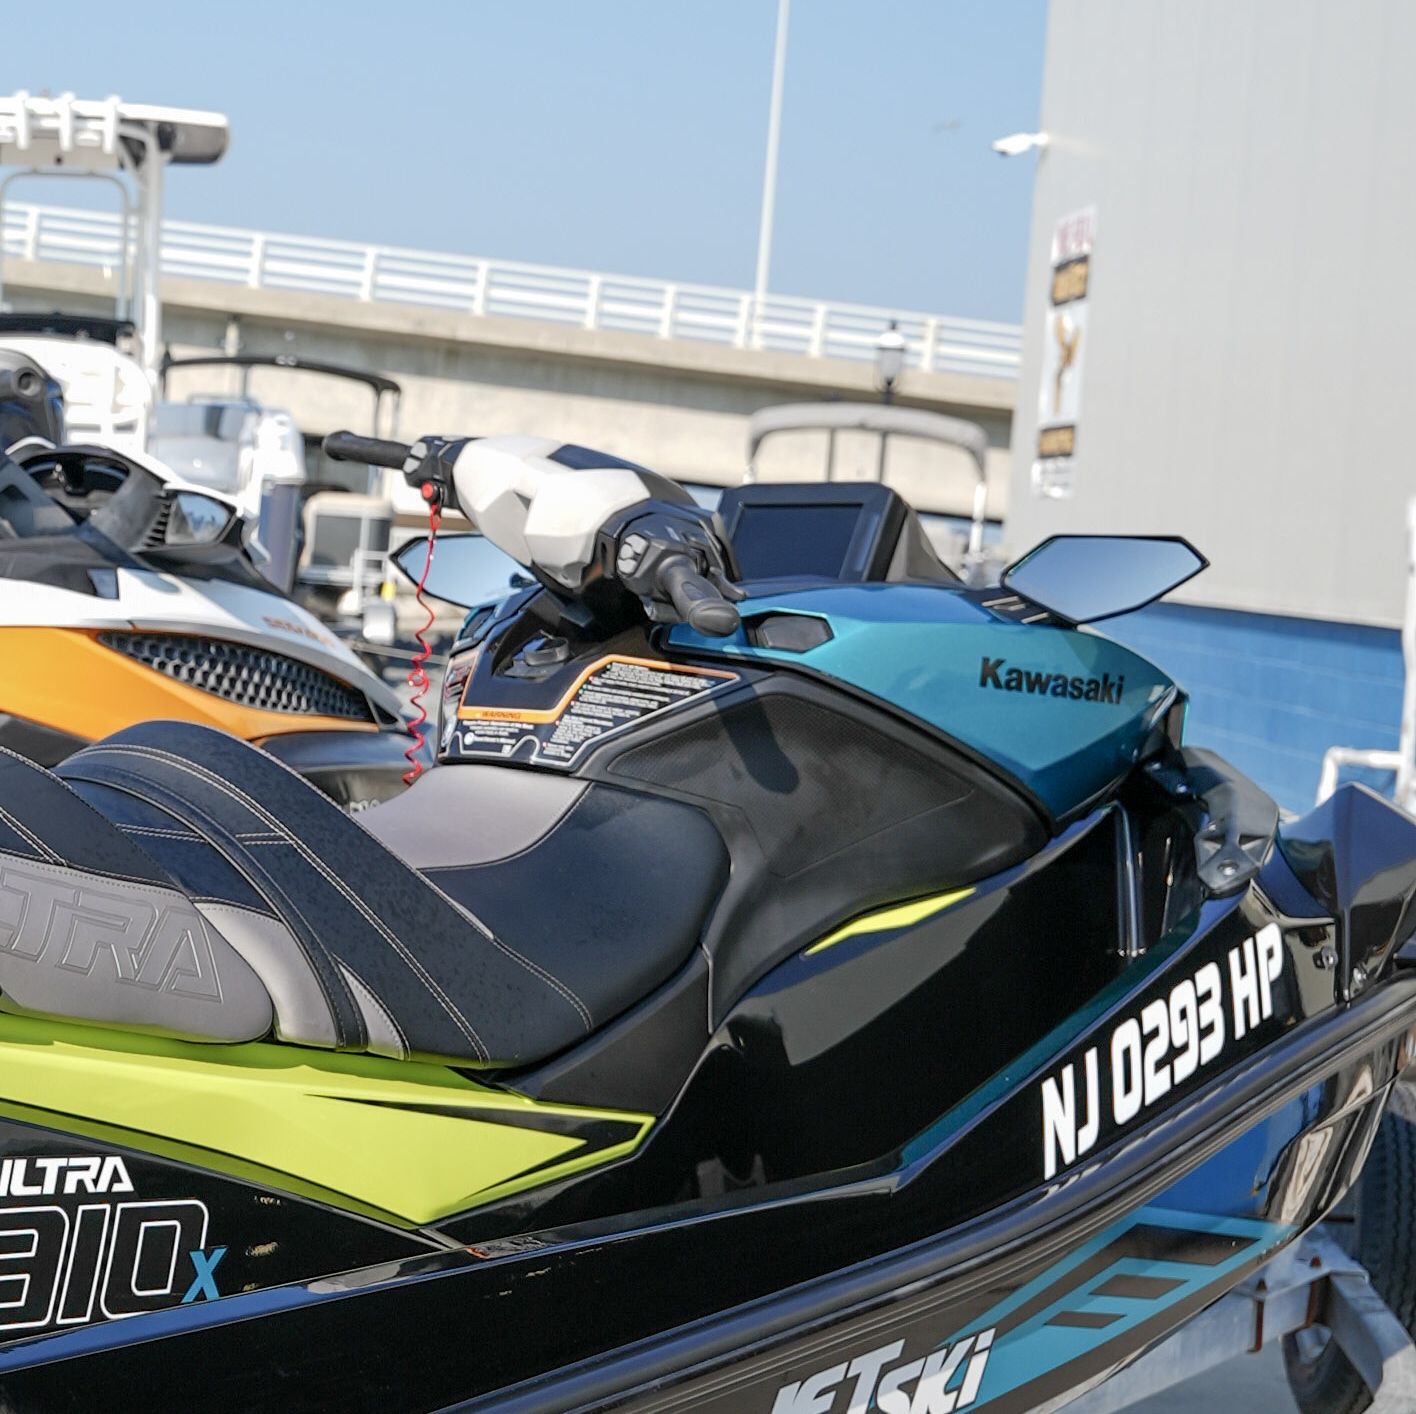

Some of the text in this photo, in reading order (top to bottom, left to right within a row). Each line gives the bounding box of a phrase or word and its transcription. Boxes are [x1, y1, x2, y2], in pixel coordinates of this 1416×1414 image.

[979, 656, 1125, 705] Kawasaki
[1041, 922, 1283, 1181] NJ 0293 HP
